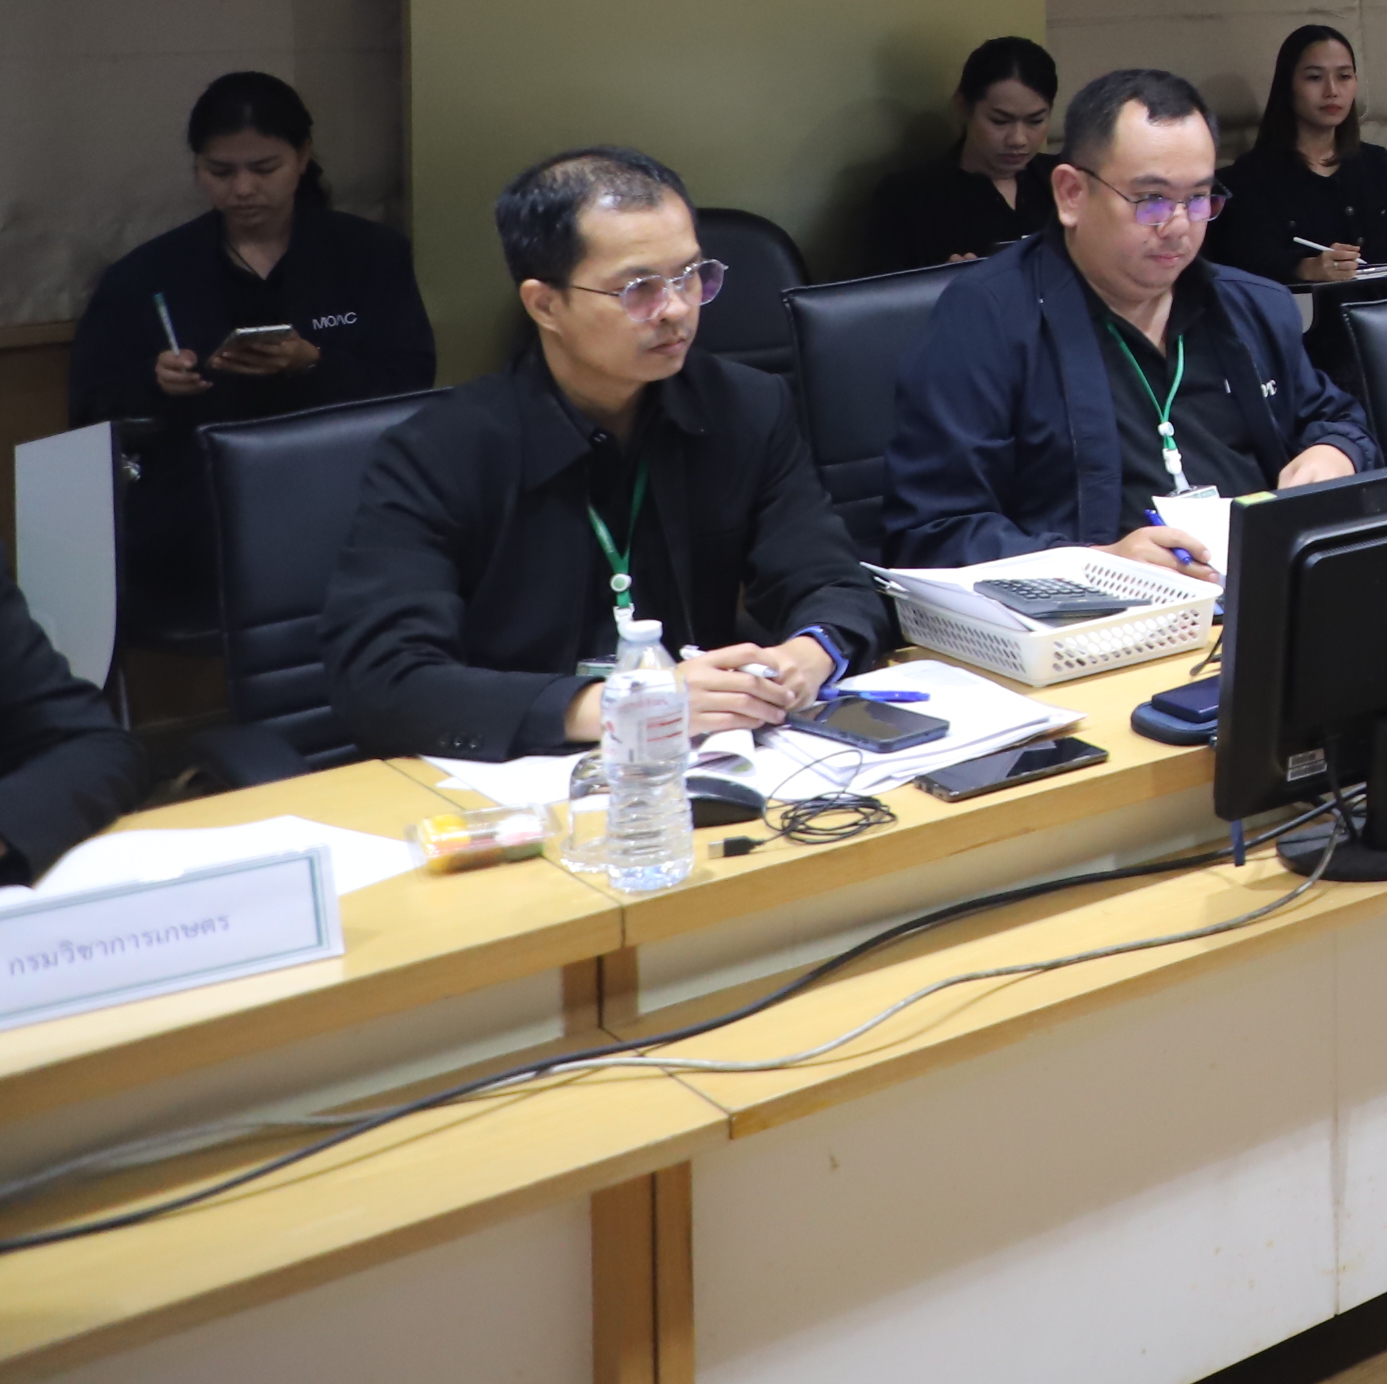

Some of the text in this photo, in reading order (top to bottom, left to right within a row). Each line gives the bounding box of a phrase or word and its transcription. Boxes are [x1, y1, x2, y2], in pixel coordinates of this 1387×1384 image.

[7, 914, 231, 977] กรมวิชาการเกษตร
